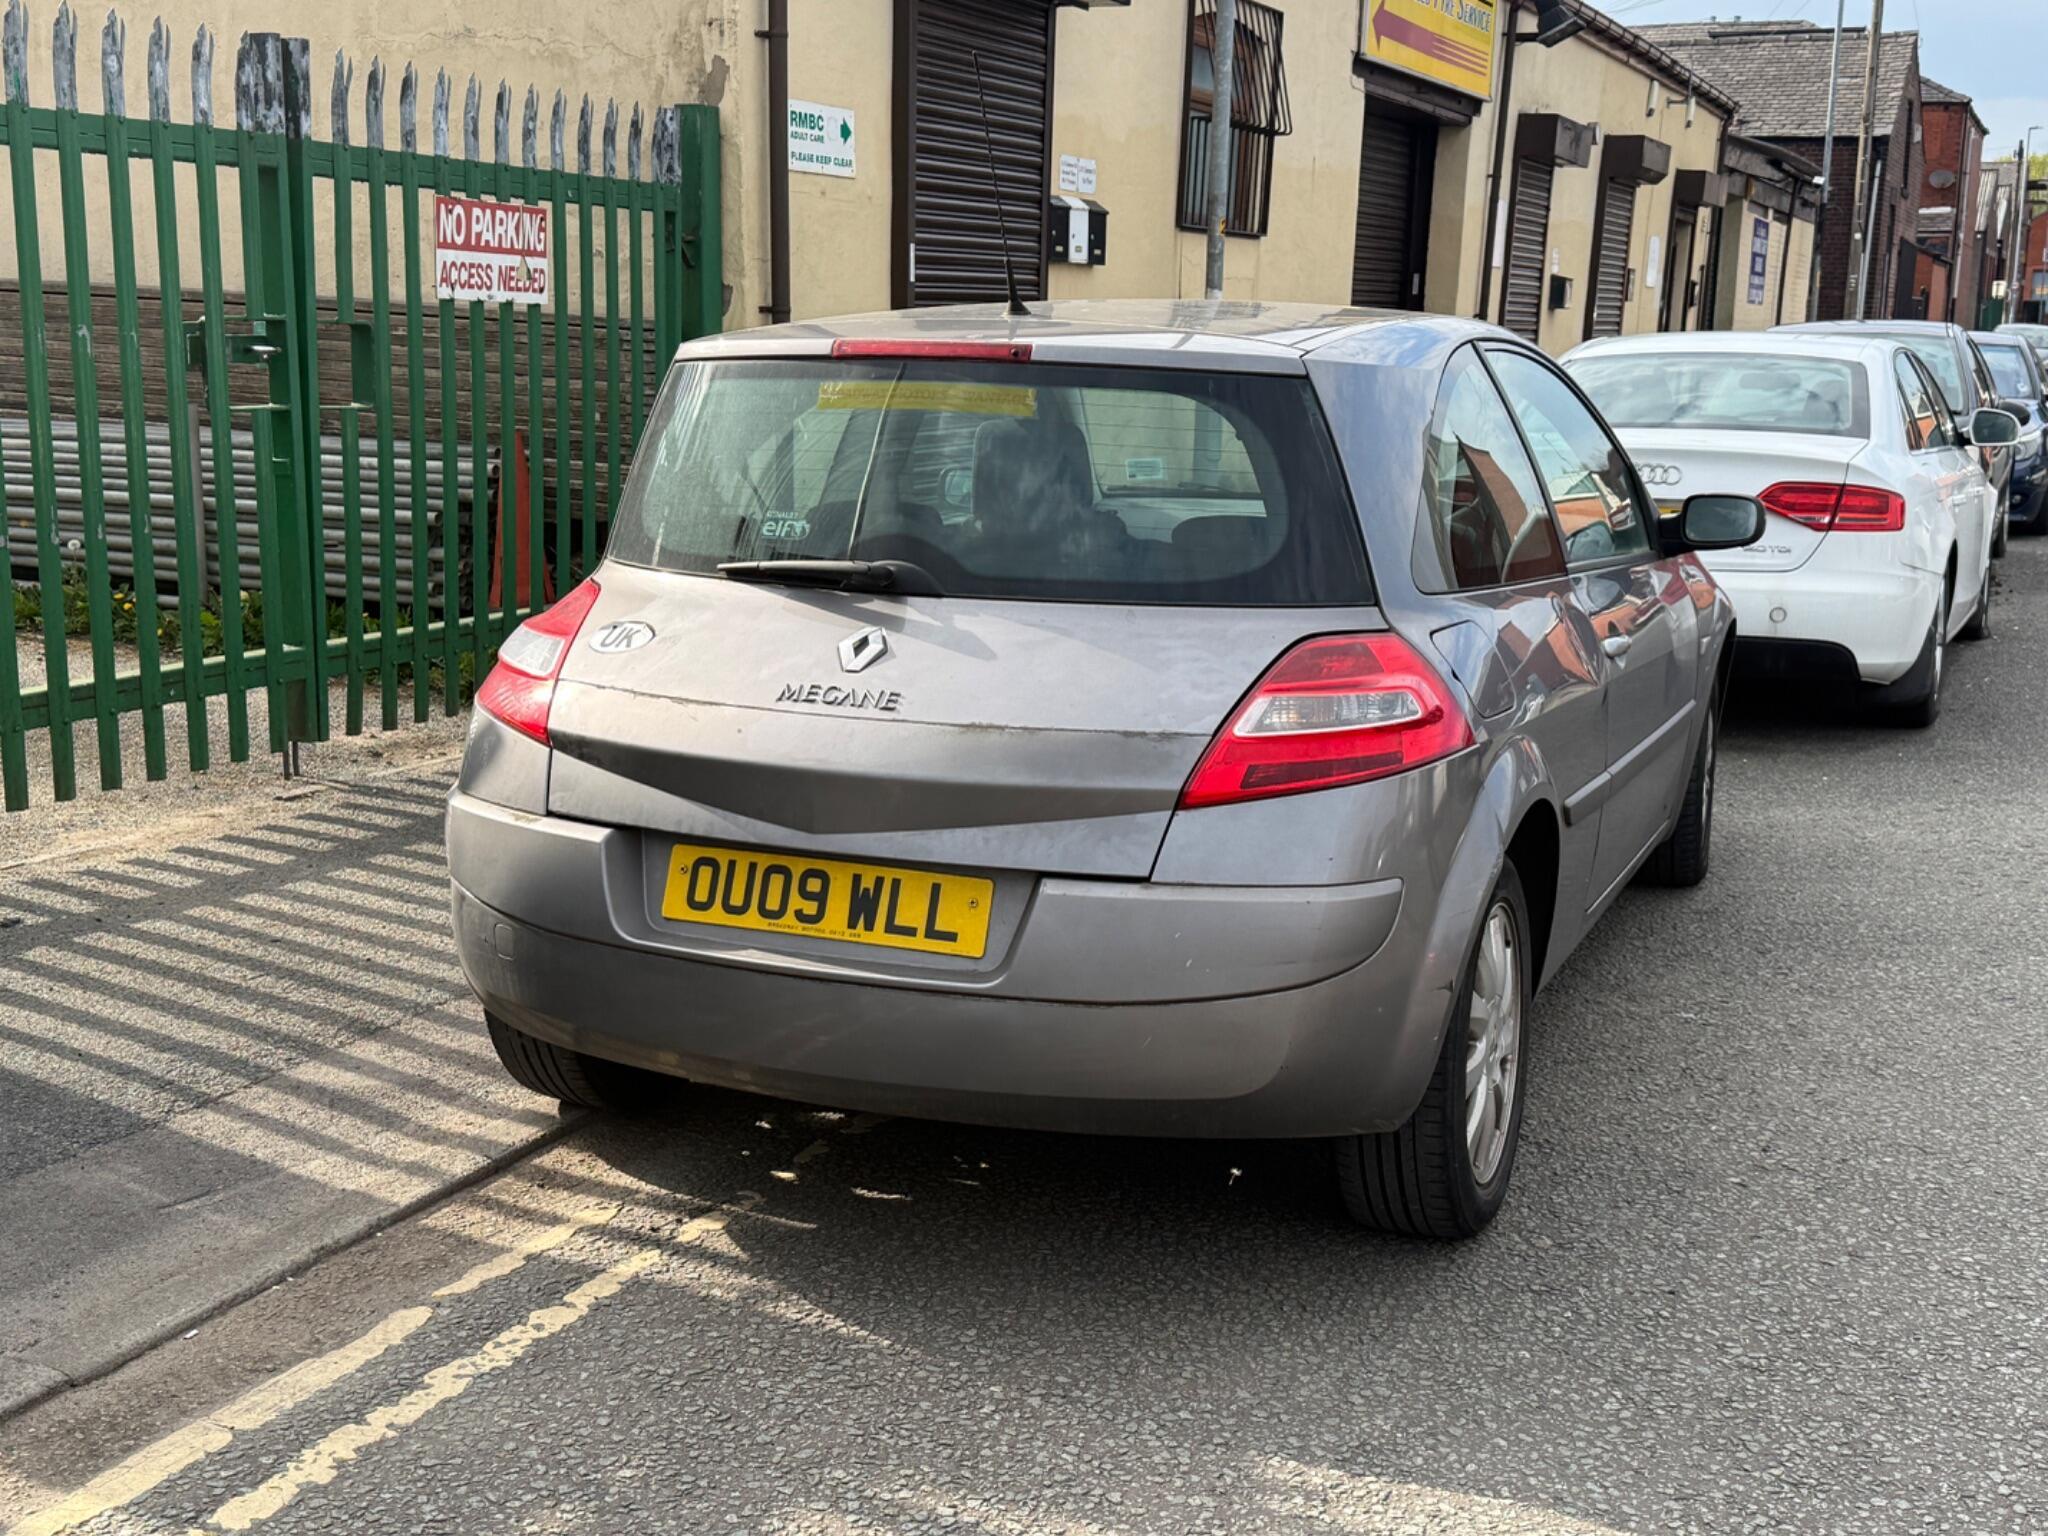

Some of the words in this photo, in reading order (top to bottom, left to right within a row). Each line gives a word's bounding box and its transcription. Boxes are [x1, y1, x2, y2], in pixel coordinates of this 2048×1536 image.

[790, 110, 824, 131] RMBC
[791, 131, 808, 141] ADULT
[810, 134, 825, 144] CARE
[791, 151, 814, 162] PLEASE
[816, 154, 832, 164] KEEP
[833, 157, 853, 168] CLEAR
[440, 203, 466, 245] NO
[471, 207, 545, 252] PARKING
[439, 260, 493, 291] ACCESS
[762, 520, 796, 537] elf
[600, 623, 636, 649] UK
[775, 683, 902, 711] MEGANE
[686, 856, 831, 924] OU09
[847, 873, 959, 943] WLL
